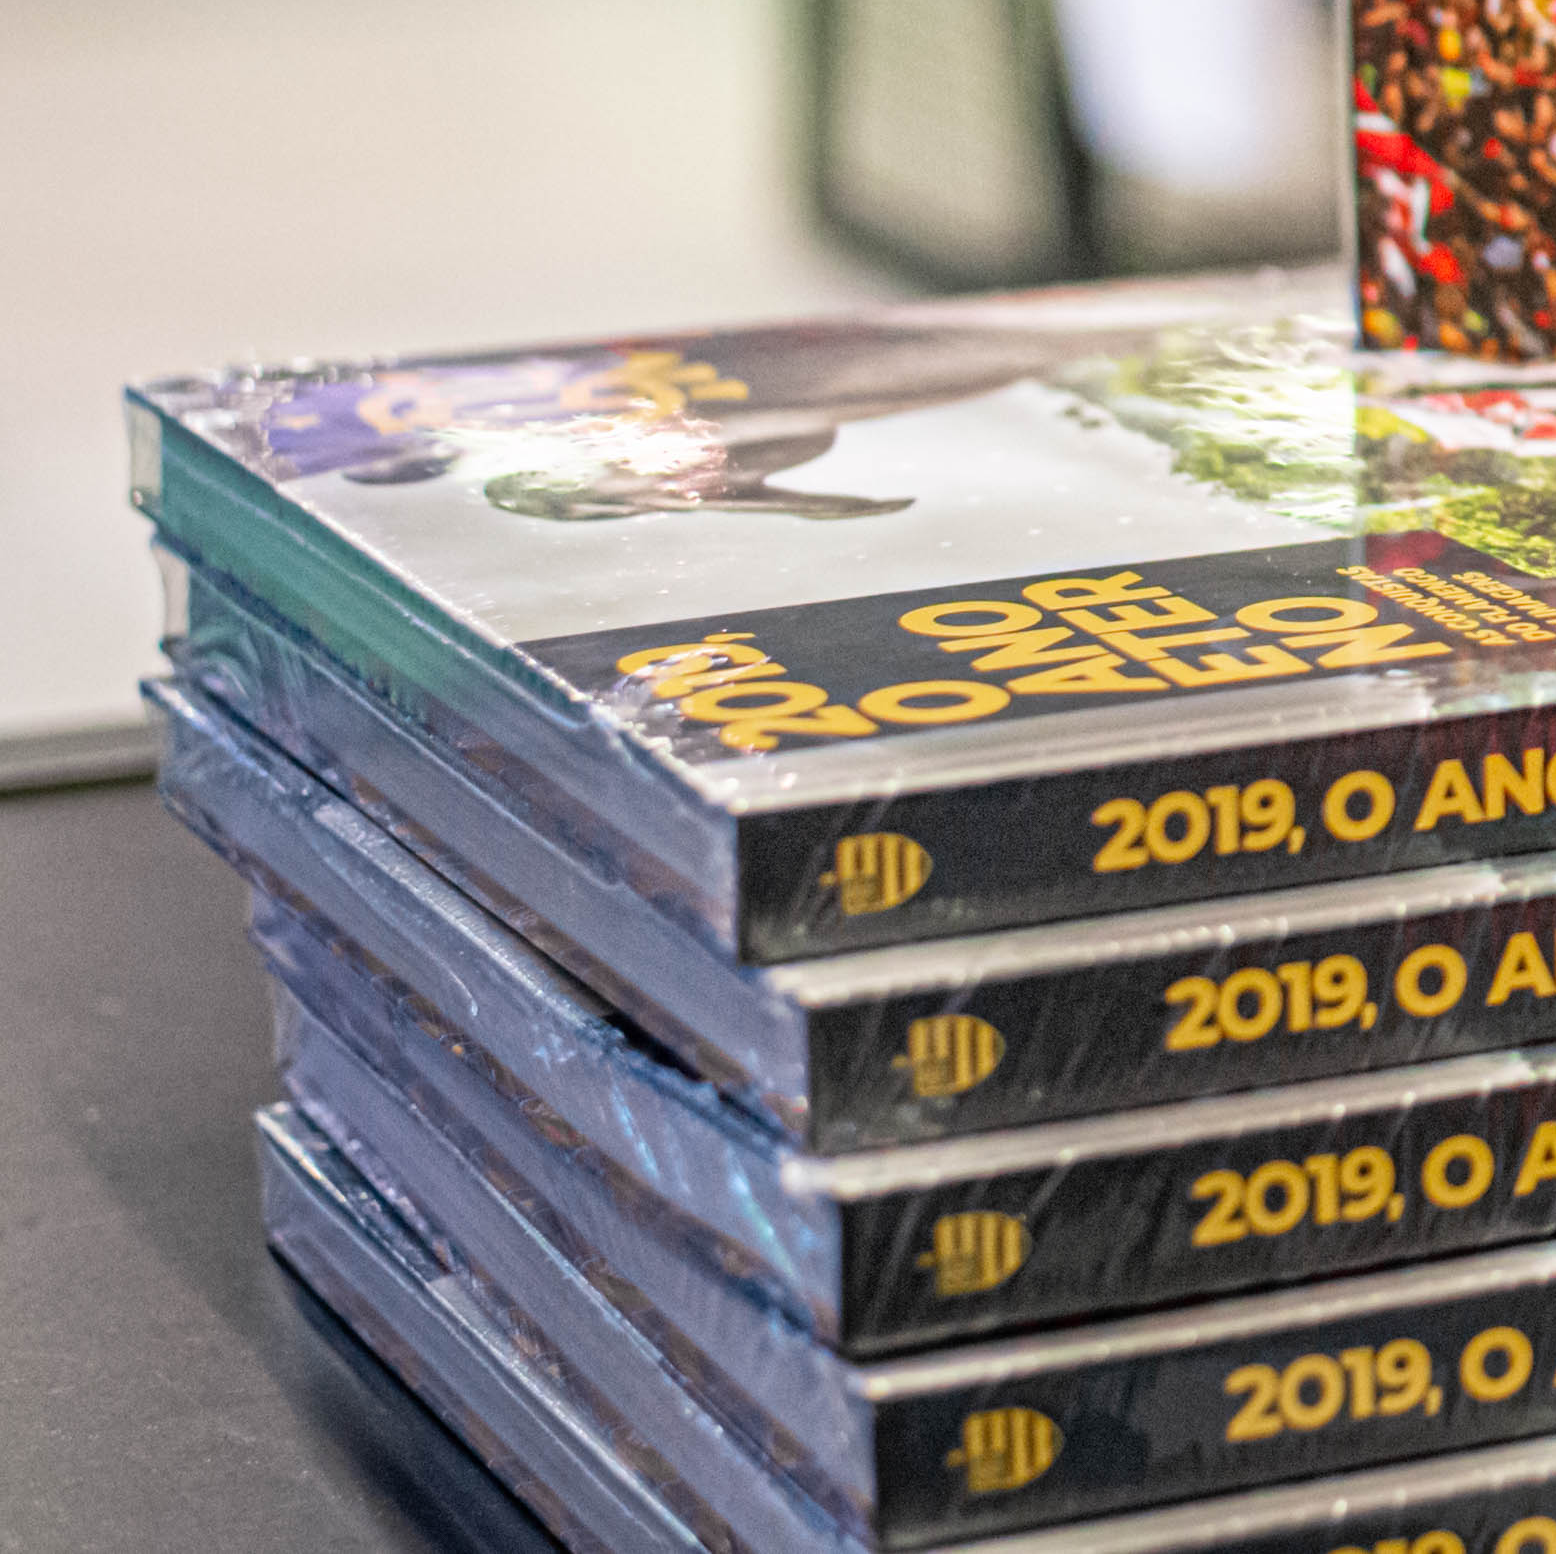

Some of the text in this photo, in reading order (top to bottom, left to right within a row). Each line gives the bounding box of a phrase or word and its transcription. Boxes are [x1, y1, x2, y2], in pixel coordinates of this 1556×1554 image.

[1020, 569, 1315, 688] ETER
[1234, 595, 1456, 671] NO
[1335, 565, 1519, 646] AS CONQUISTAS
[1392, 566, 1522, 624] FLAMENGO
[897, 599, 1173, 695] ANO
[857, 679, 1012, 725] O
[1093, 778, 1306, 873] 2019,
[1322, 769, 1396, 842] O
[1165, 954, 1378, 1051] 2019,
[1394, 944, 1468, 1018] O
[1191, 1145, 1405, 1247] 2019,
[1421, 1134, 1495, 1209] O
[1225, 1339, 1443, 1442] 2019,
[1460, 1326, 1533, 1402] O
